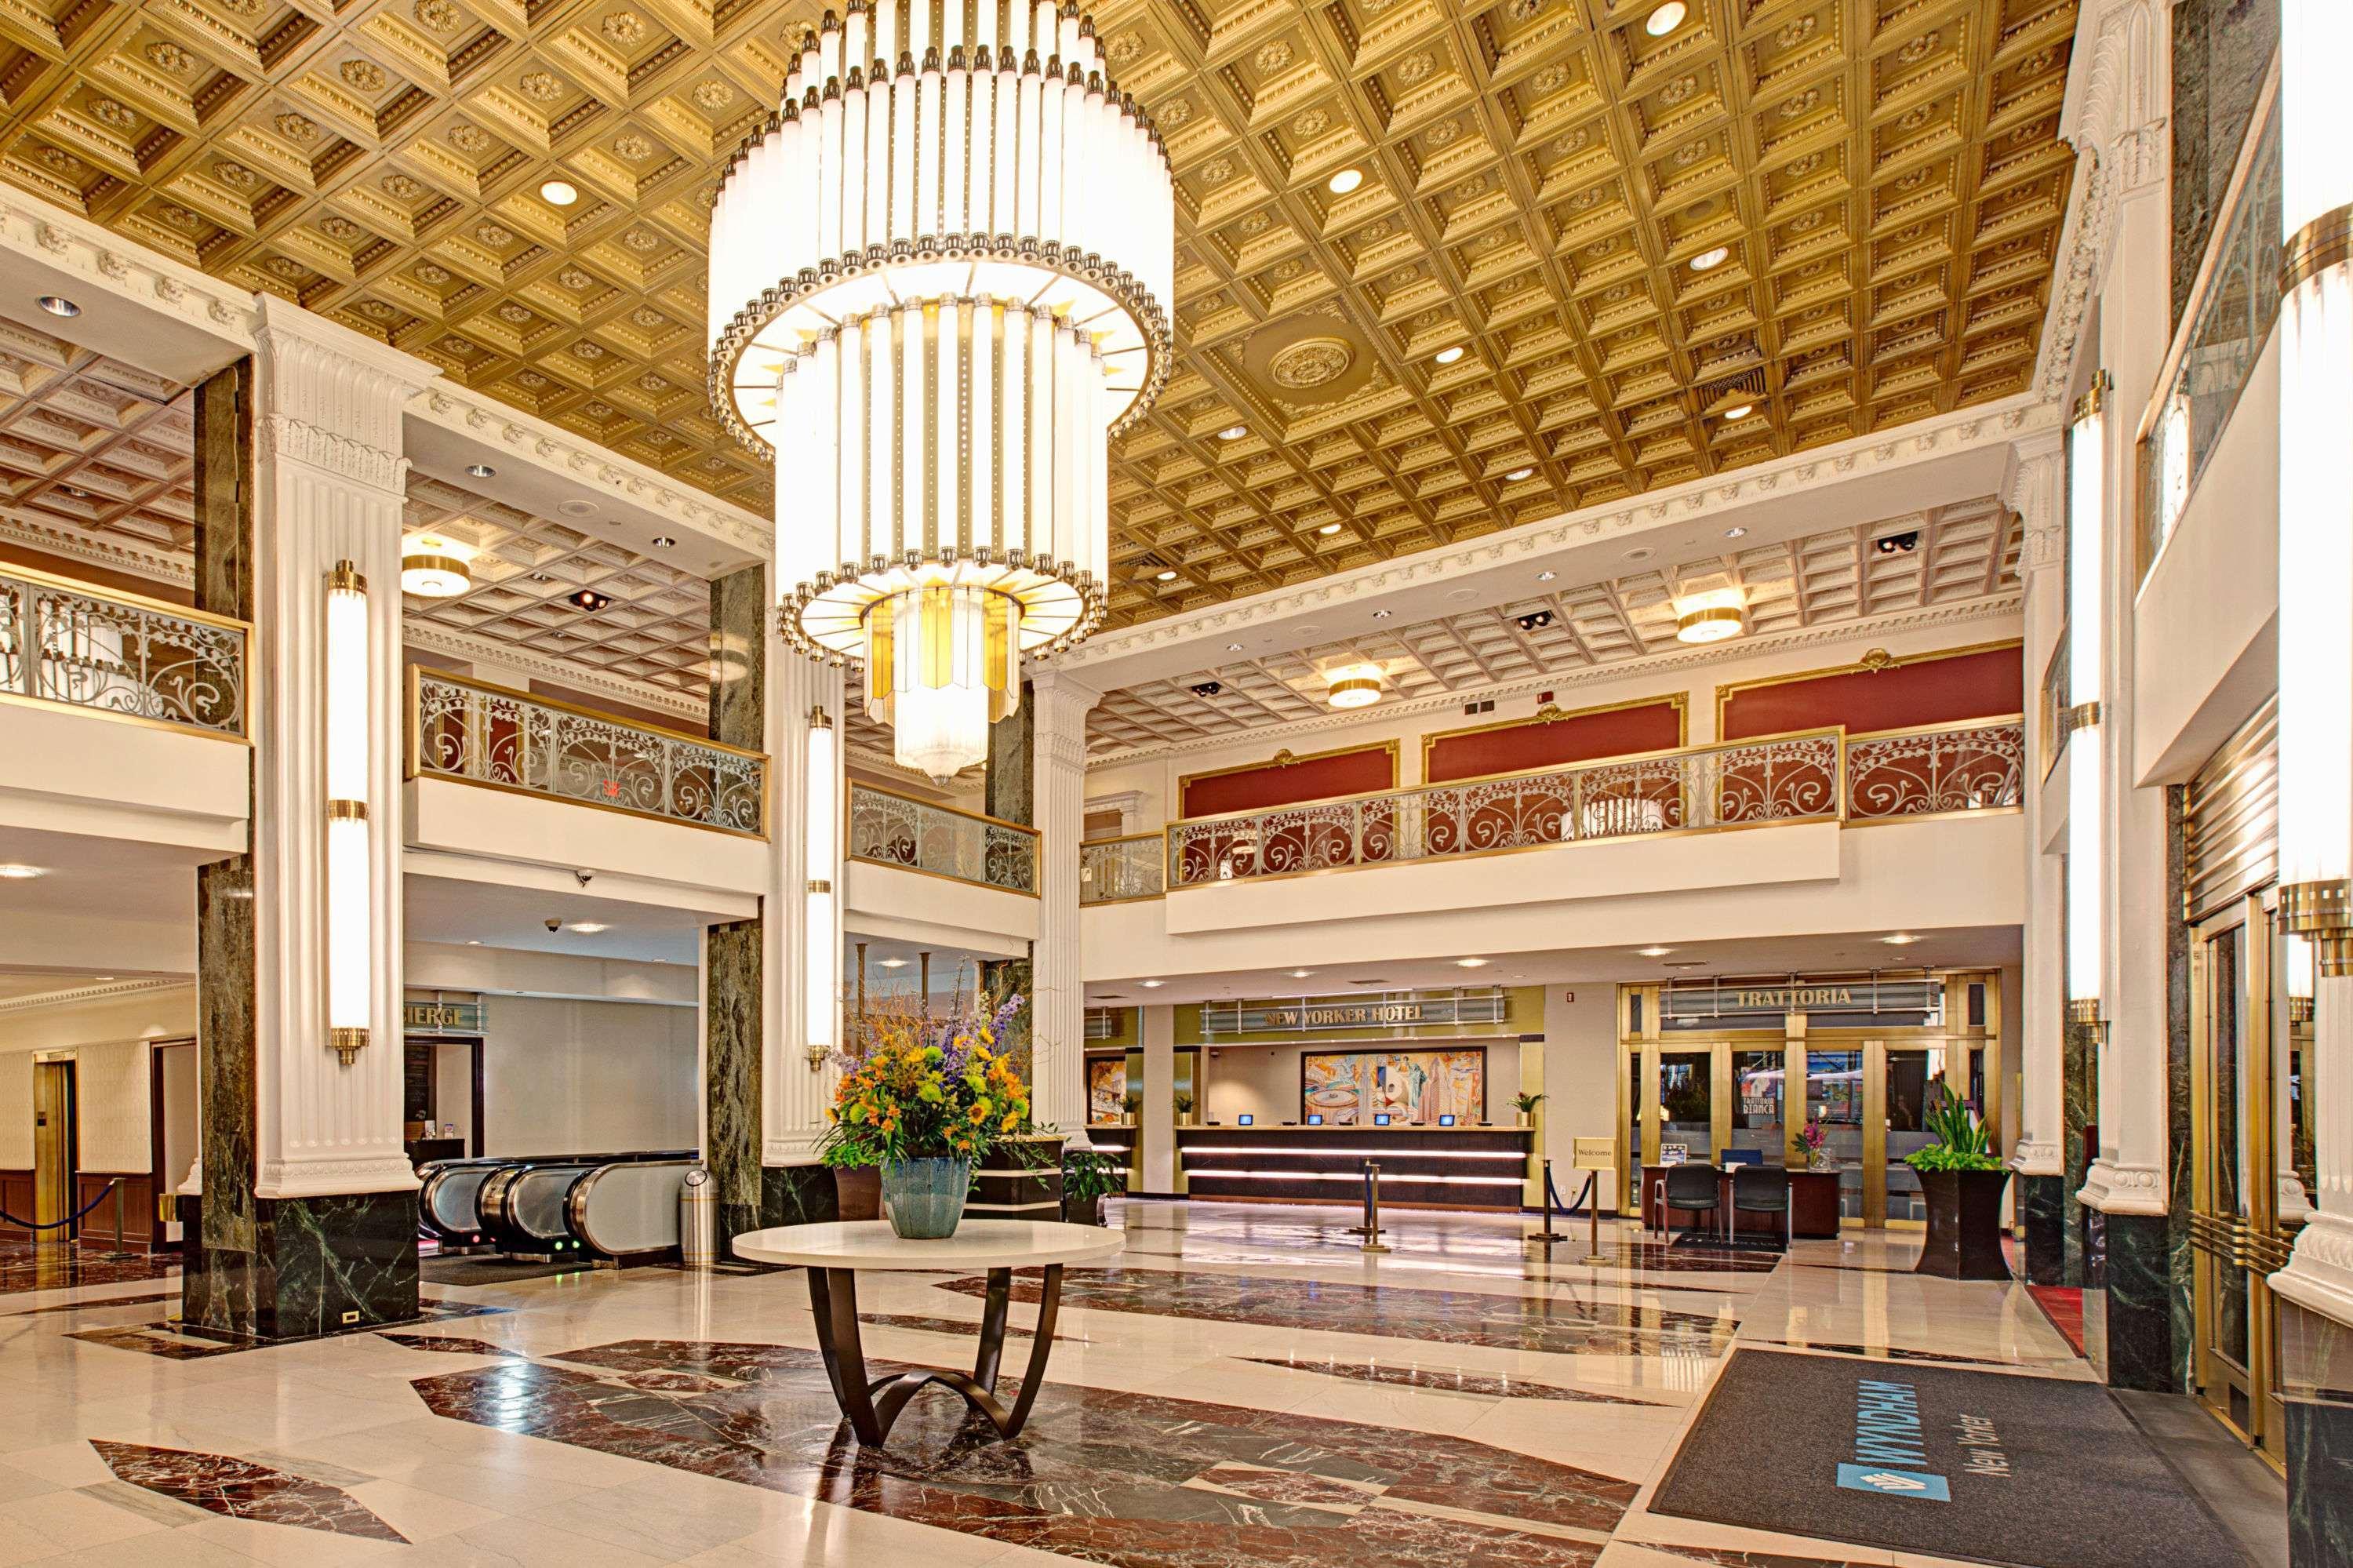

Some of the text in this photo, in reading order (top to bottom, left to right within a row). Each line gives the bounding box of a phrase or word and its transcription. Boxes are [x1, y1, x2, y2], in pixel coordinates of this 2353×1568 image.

[1737, 988, 1852, 1007] TRATTORIA
[1265, 1005, 1425, 1026] NEW YORKER HOTEL
[1743, 1104, 1775, 1115] BIANCA
[1856, 1380, 1928, 1465] WYNDHAM
[1951, 1413, 2011, 1477] New Yorker
